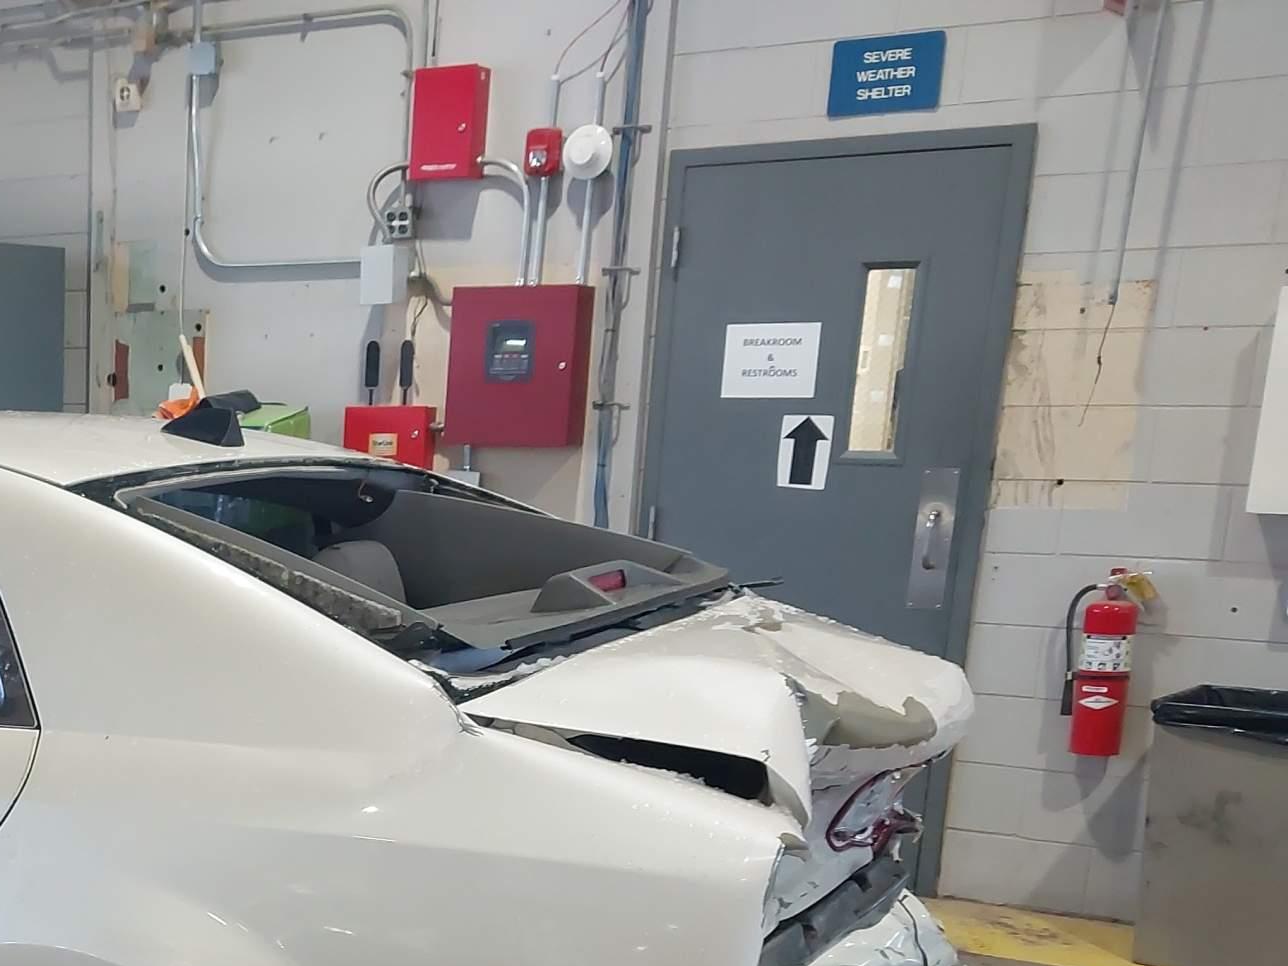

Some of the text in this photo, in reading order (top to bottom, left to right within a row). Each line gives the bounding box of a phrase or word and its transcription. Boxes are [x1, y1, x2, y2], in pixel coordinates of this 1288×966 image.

[863, 48, 912, 63] SEVERE
[856, 66, 916, 82] WEATHER
[856, 85, 911, 100] SHELTER
[743, 338, 802, 347] BREAKROOM
[741, 368, 797, 377] RESTROOMS
